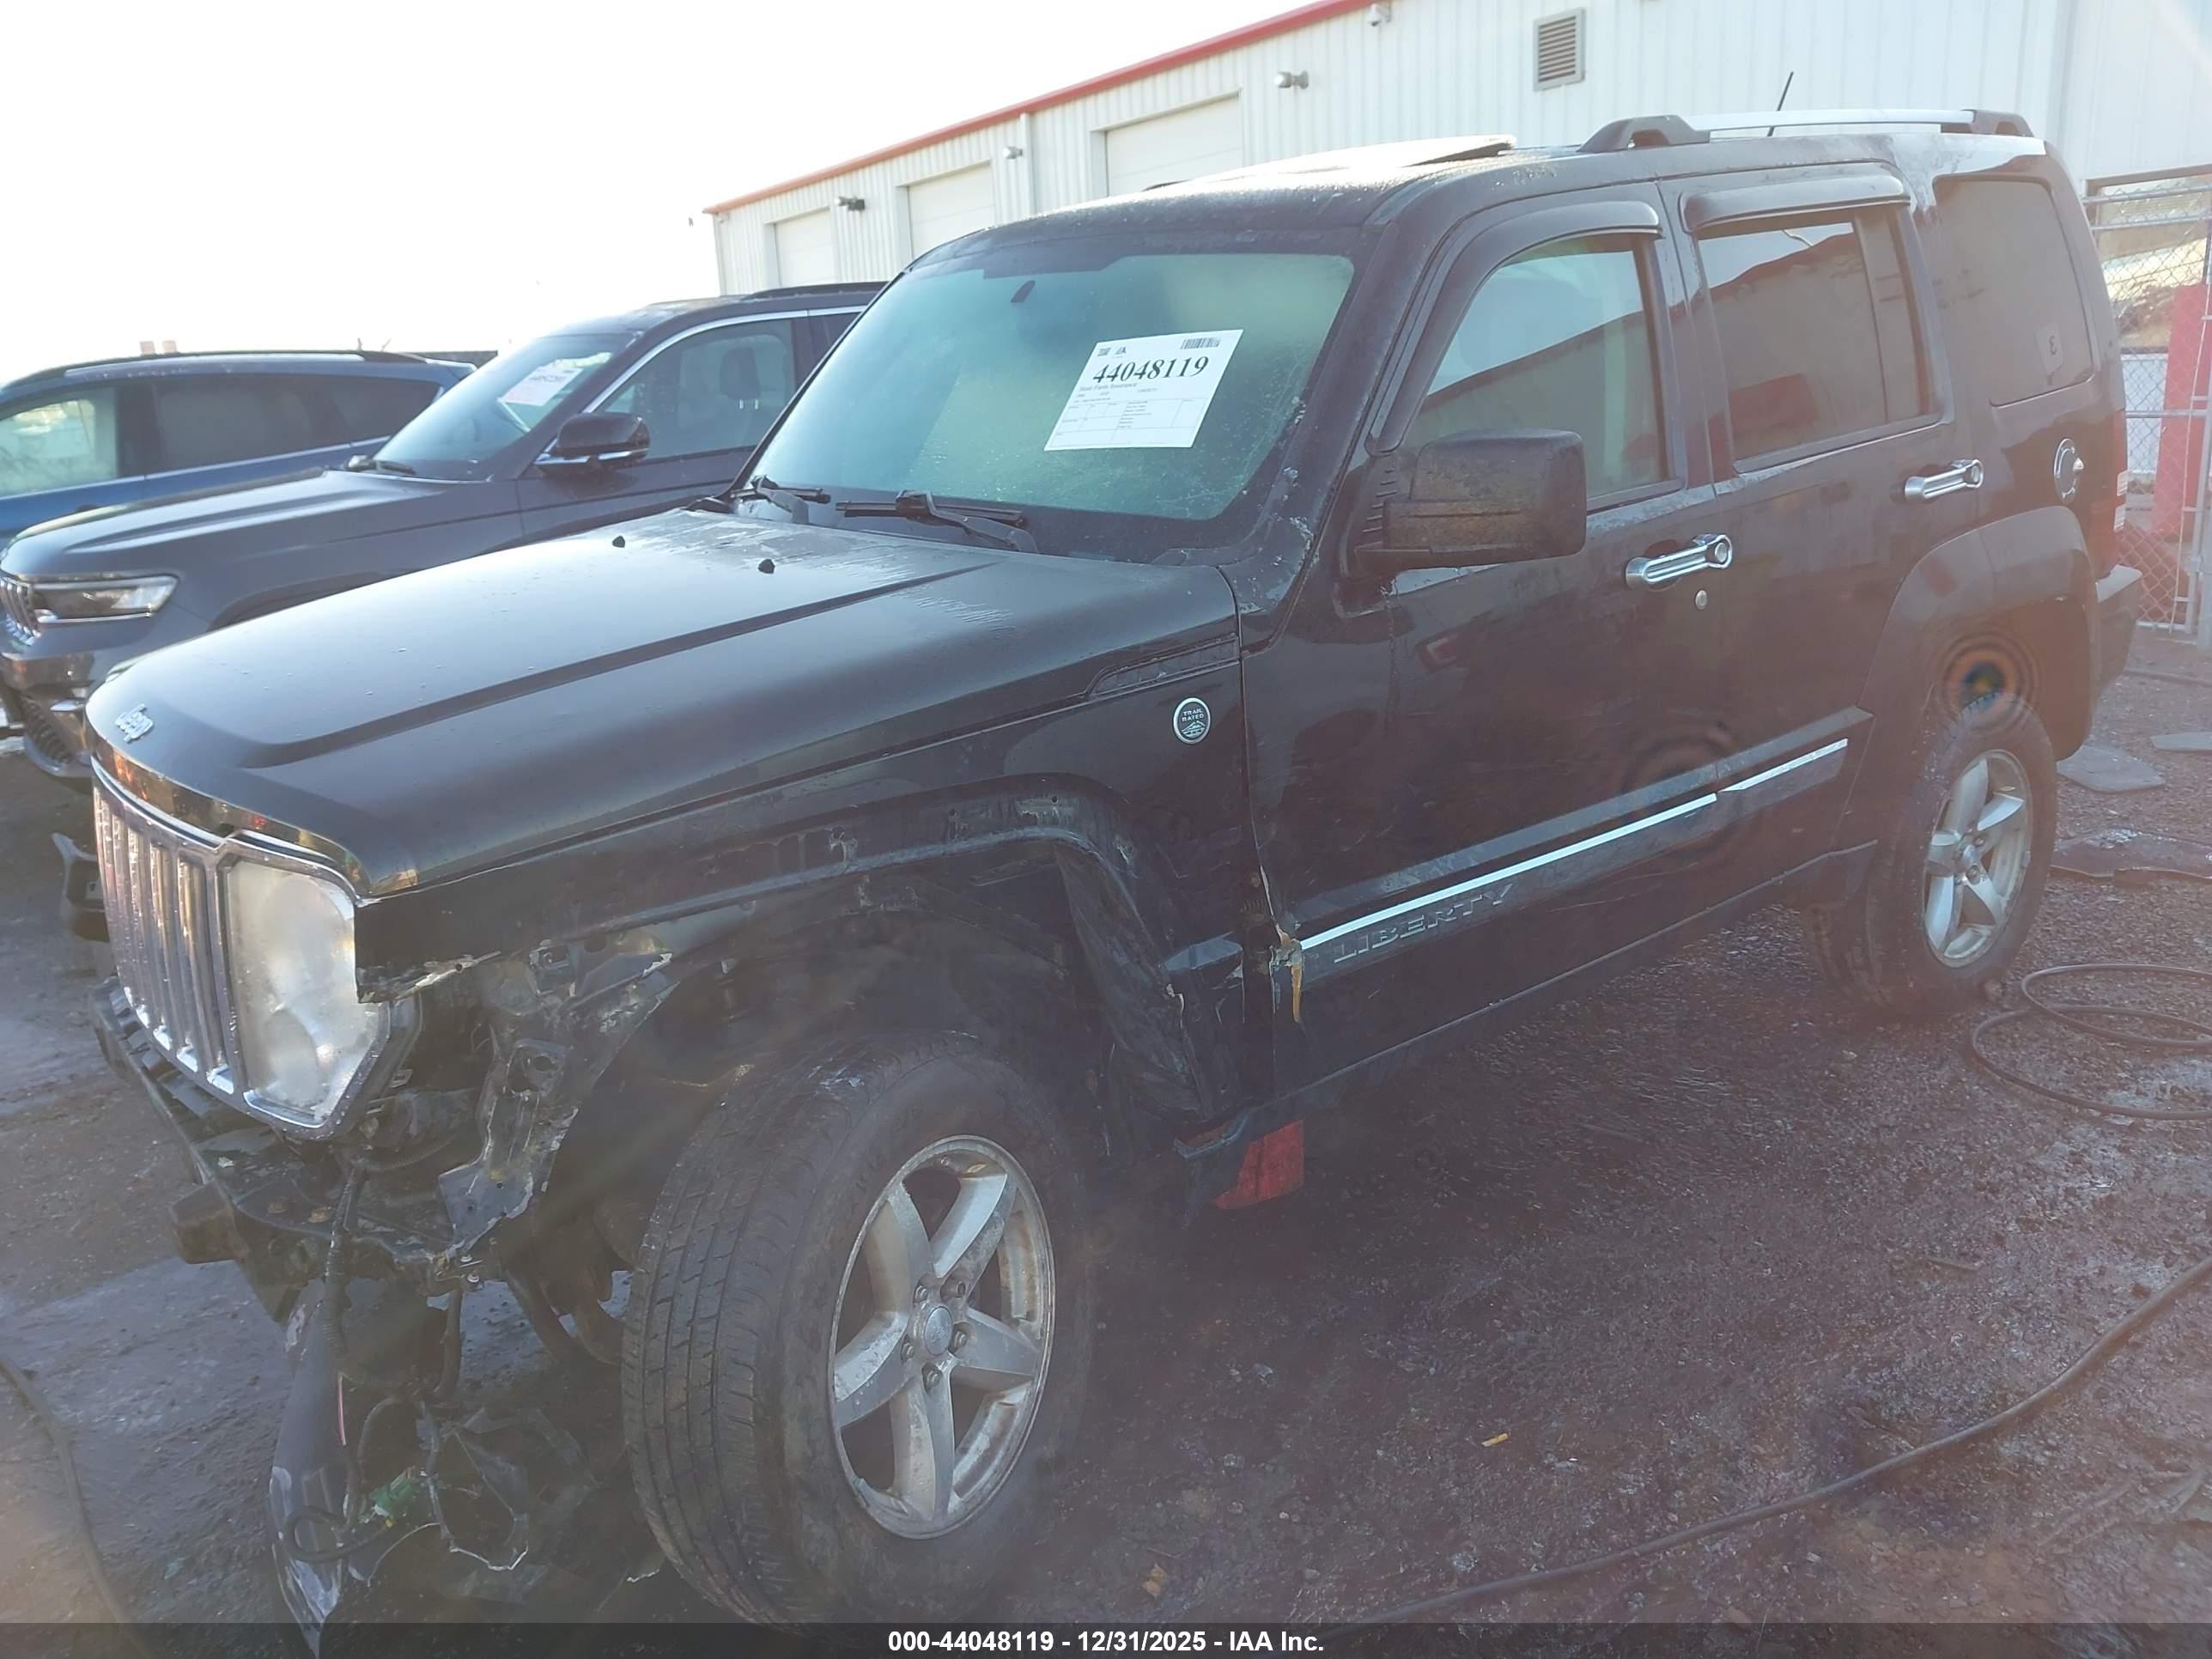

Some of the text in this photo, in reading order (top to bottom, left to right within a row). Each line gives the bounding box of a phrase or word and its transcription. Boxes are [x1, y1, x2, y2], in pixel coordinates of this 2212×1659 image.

[1093, 356, 1209, 383] 44048119
[1182, 714, 1205, 722] RATED
[1334, 883, 1513, 963] LIBERTY
